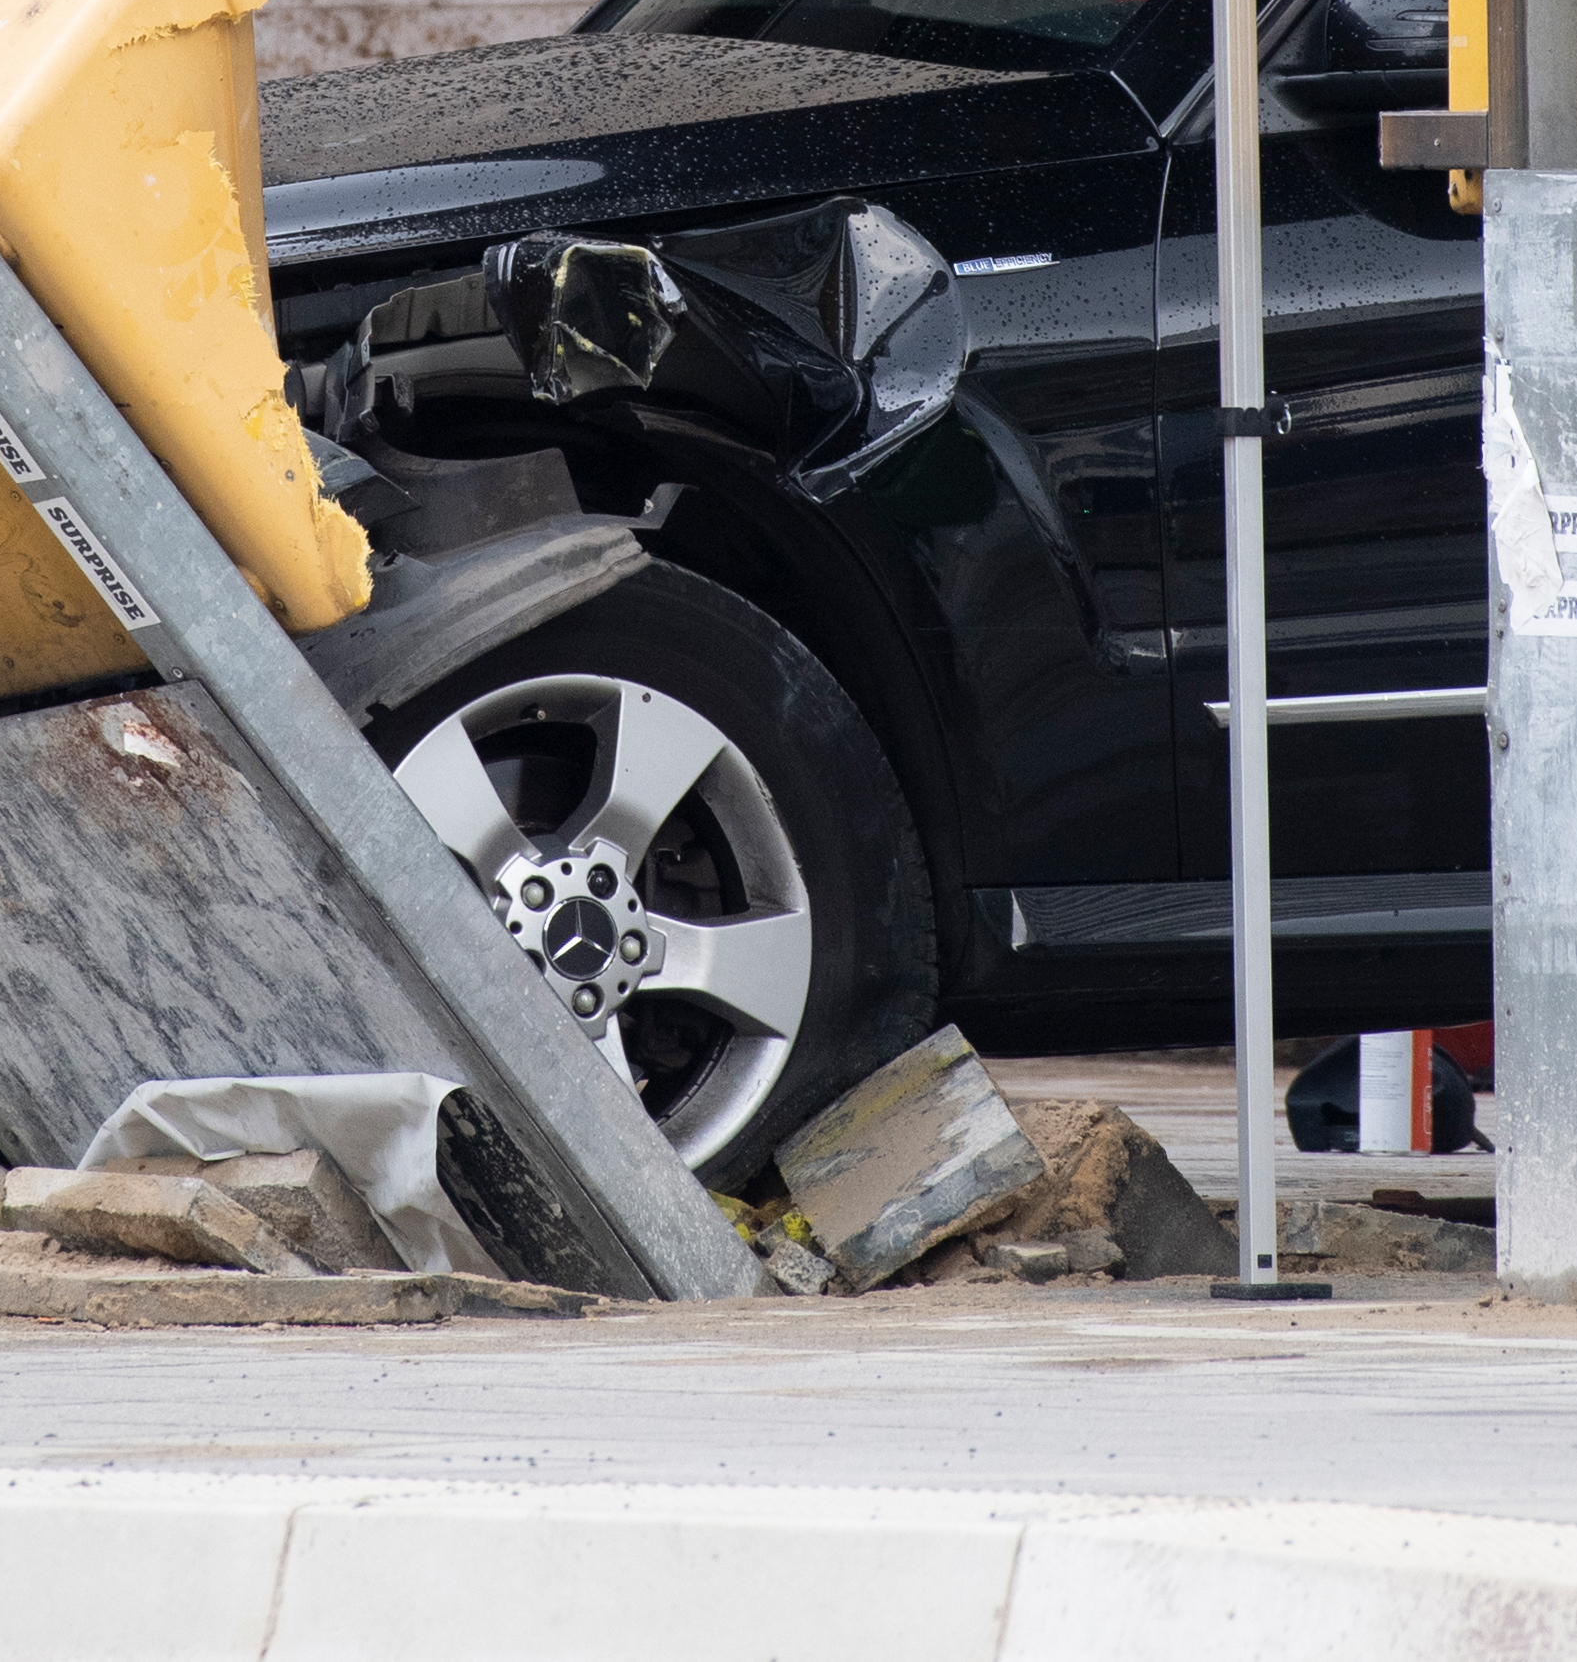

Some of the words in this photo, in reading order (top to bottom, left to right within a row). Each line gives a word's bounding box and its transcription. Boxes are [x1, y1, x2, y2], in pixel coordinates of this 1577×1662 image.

[963, 261, 989, 272] BLUE
[994, 252, 1052, 268] EFFICIENCY
[47, 507, 146, 621] SURPRISE
